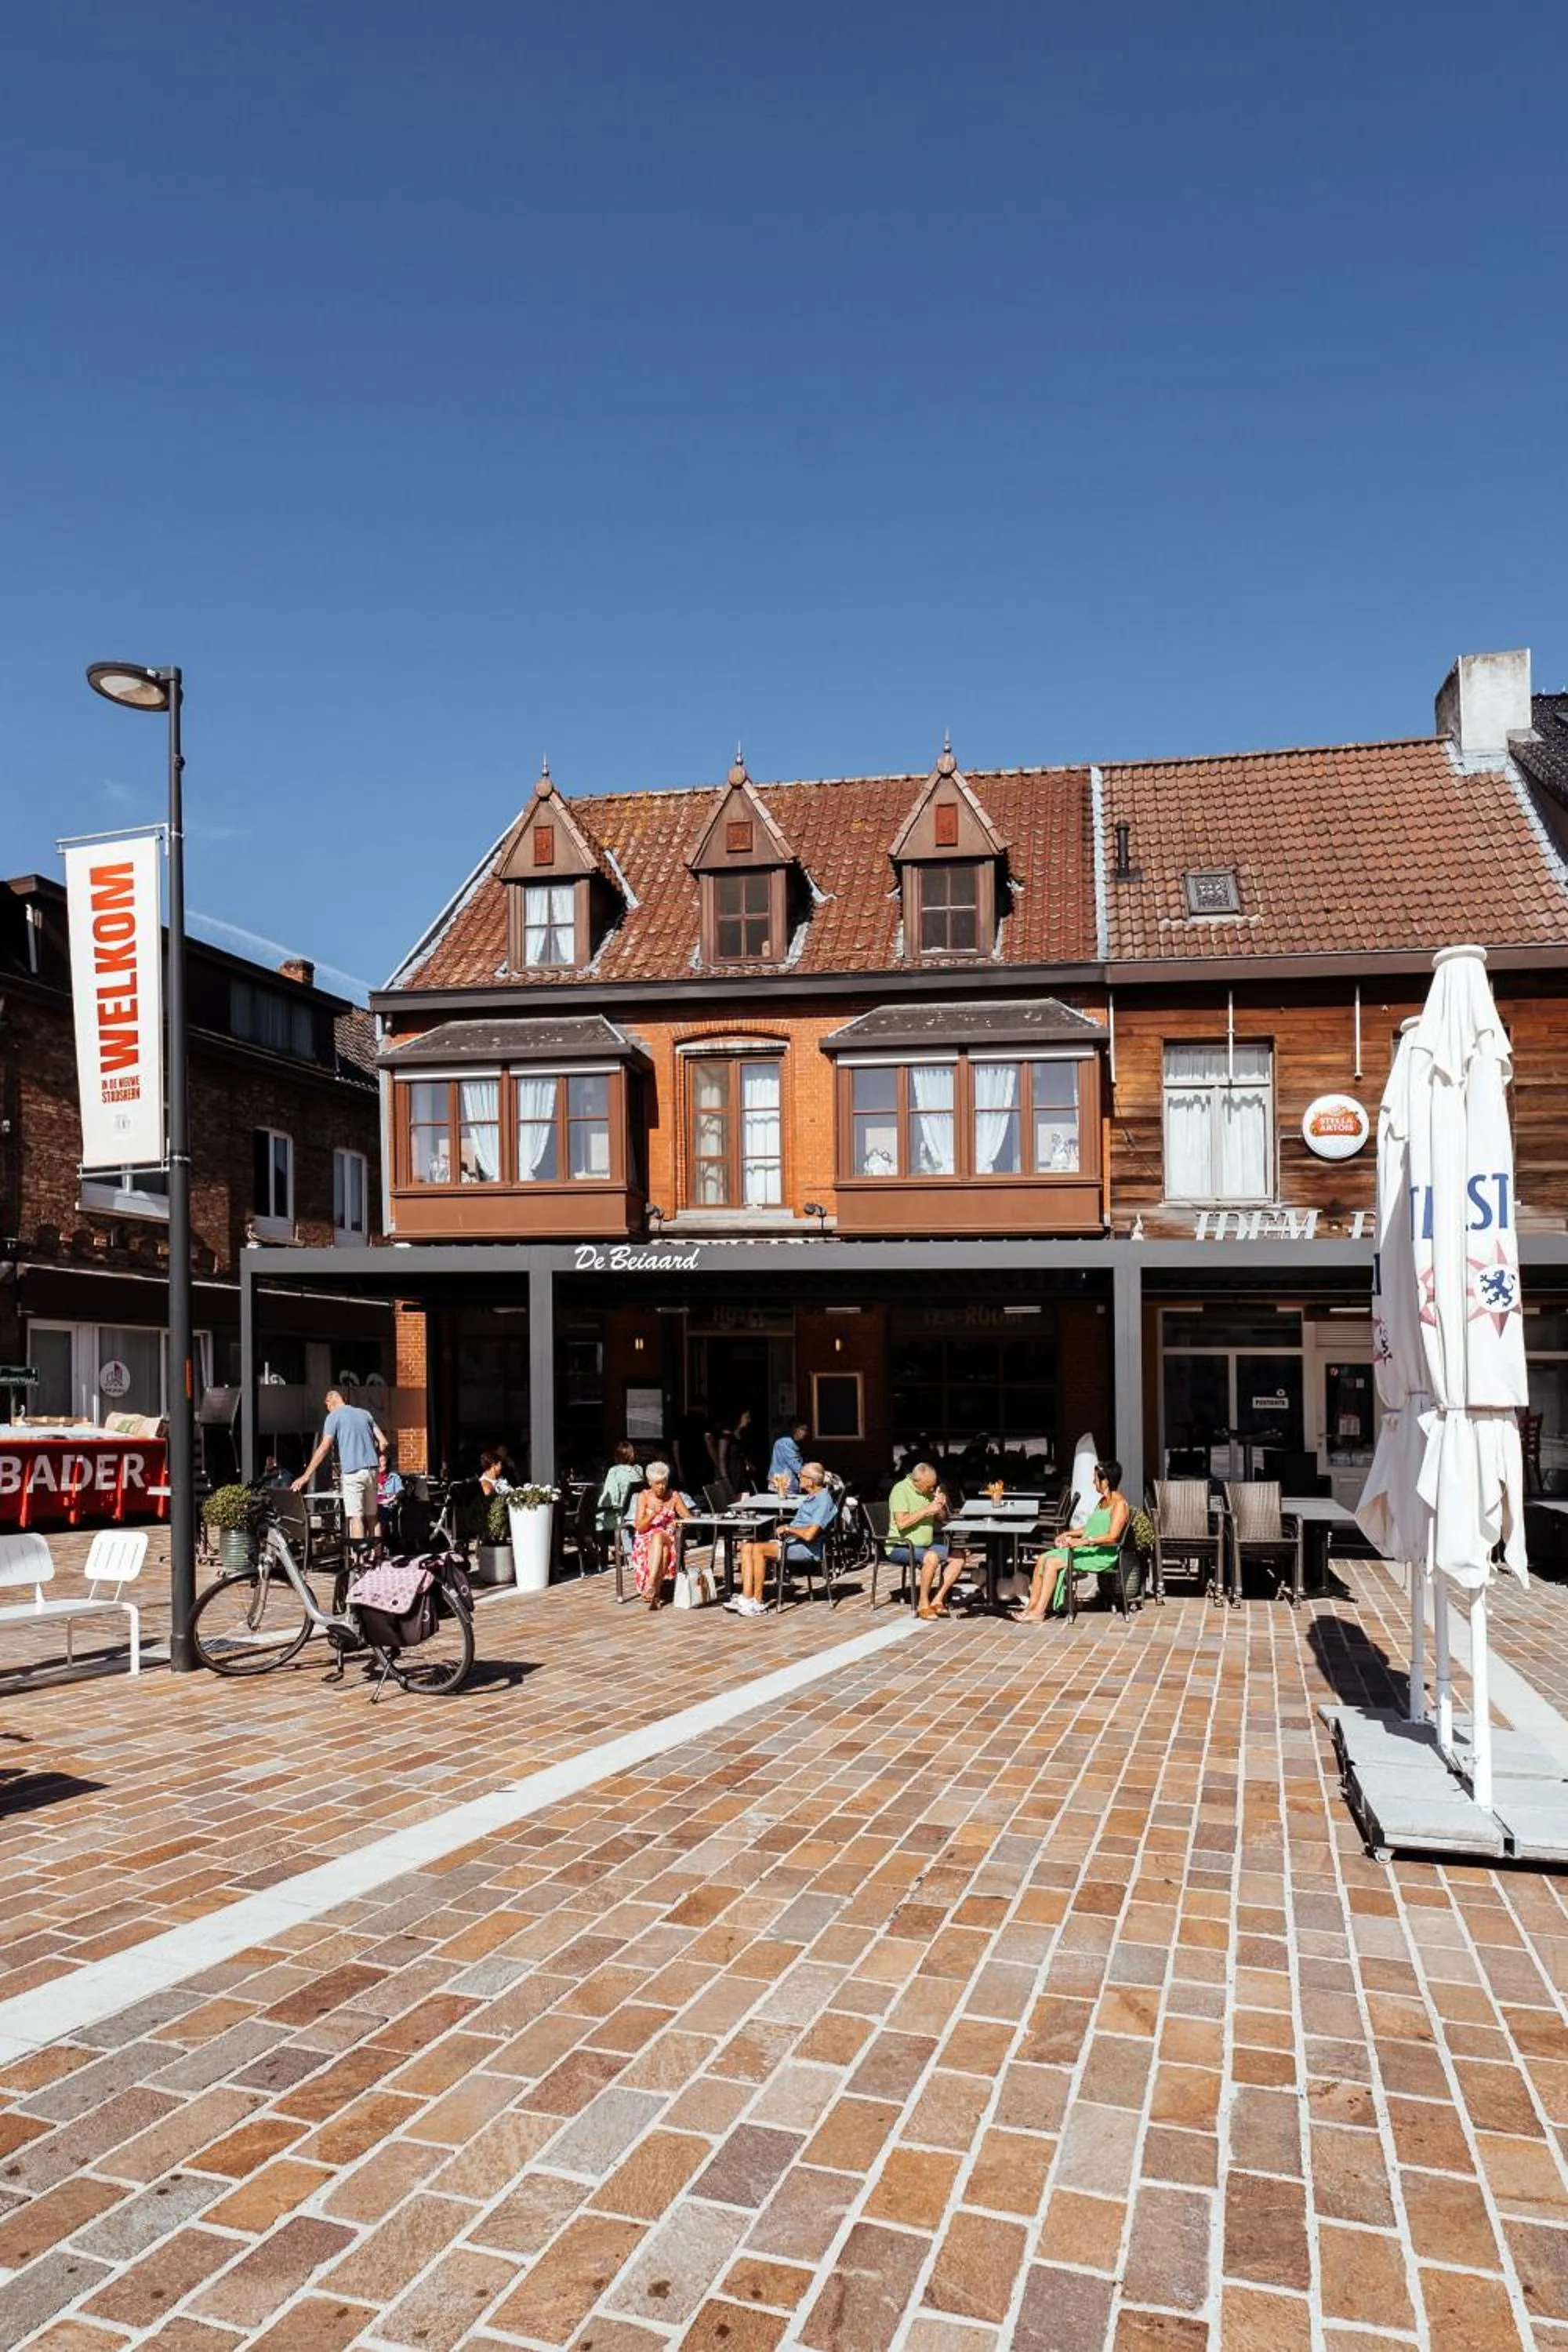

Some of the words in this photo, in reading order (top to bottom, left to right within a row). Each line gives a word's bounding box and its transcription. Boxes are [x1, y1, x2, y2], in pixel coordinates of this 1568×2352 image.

[89, 862, 140, 1073] WELKOM
[575, 1245, 605, 1269] De
[609, 1245, 700, 1270] Beiaard
